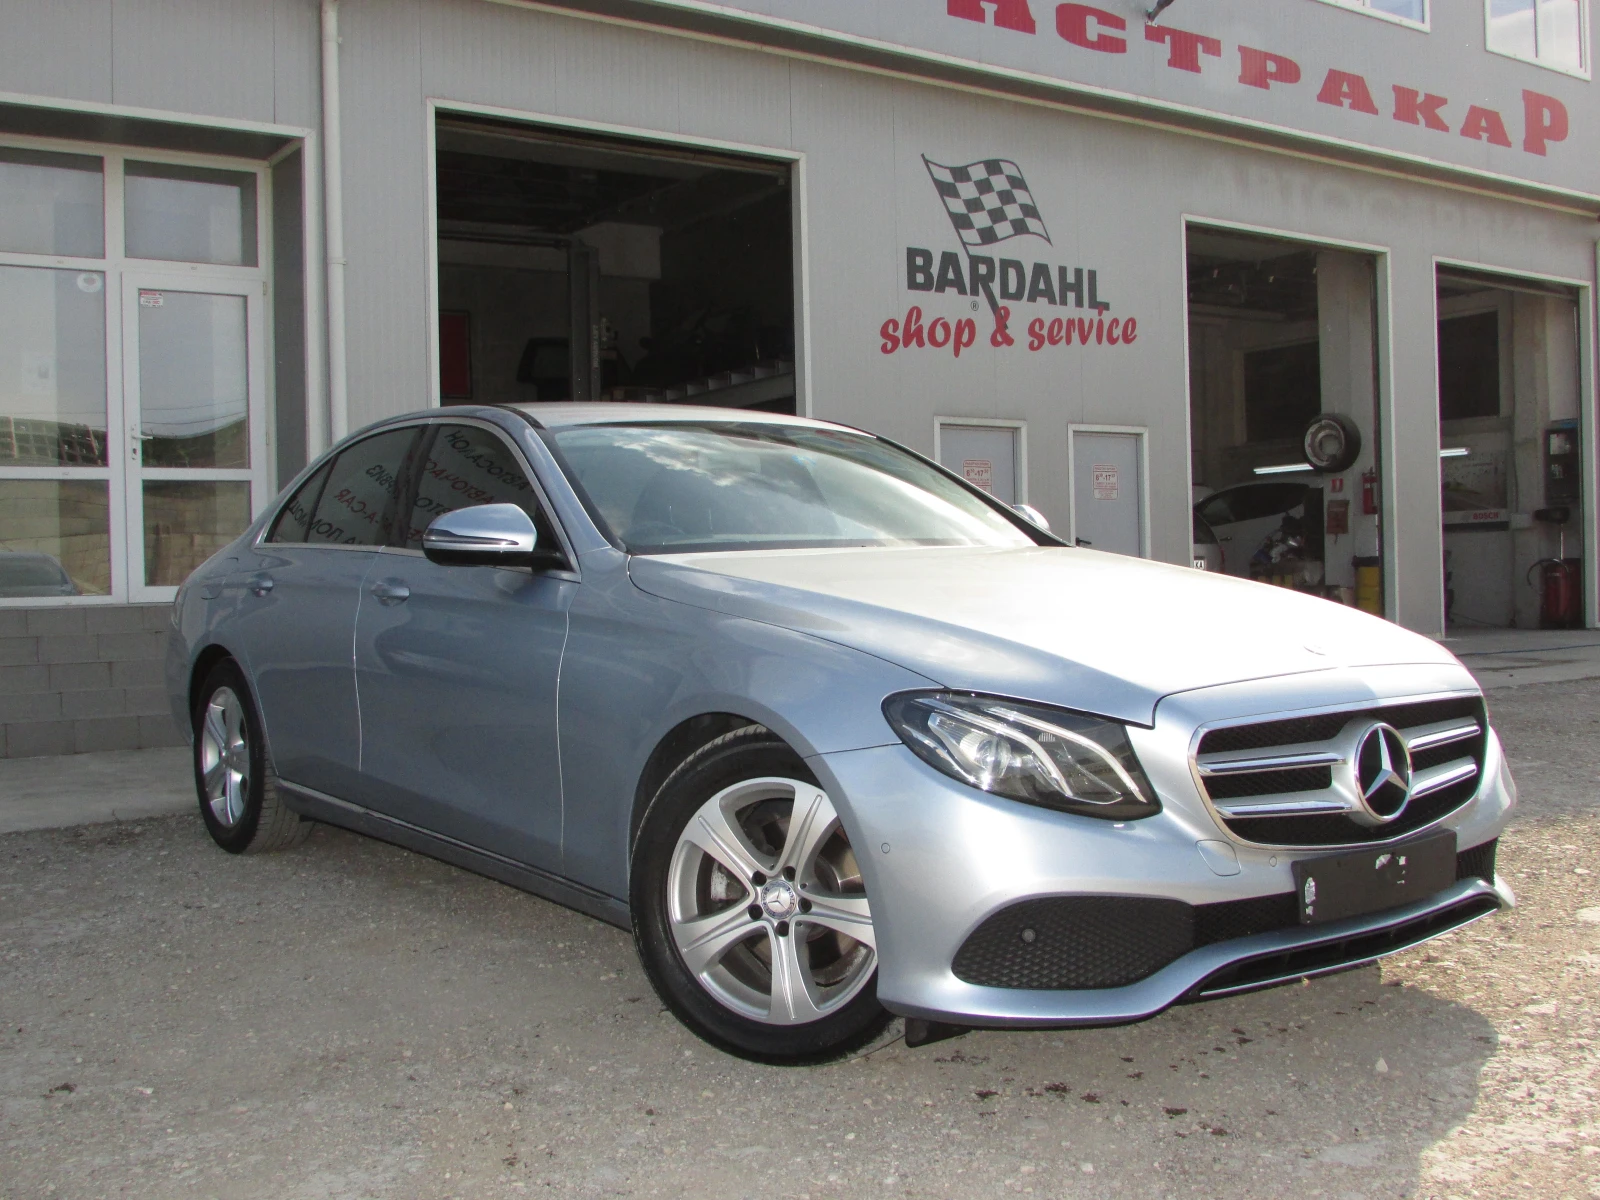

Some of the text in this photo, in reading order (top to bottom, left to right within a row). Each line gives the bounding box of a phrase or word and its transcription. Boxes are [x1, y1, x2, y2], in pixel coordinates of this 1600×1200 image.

[906, 247, 1111, 312] BARDAHL
[880, 305, 1137, 358] shop & service
[1472, 511, 1500, 521] BOSCH
